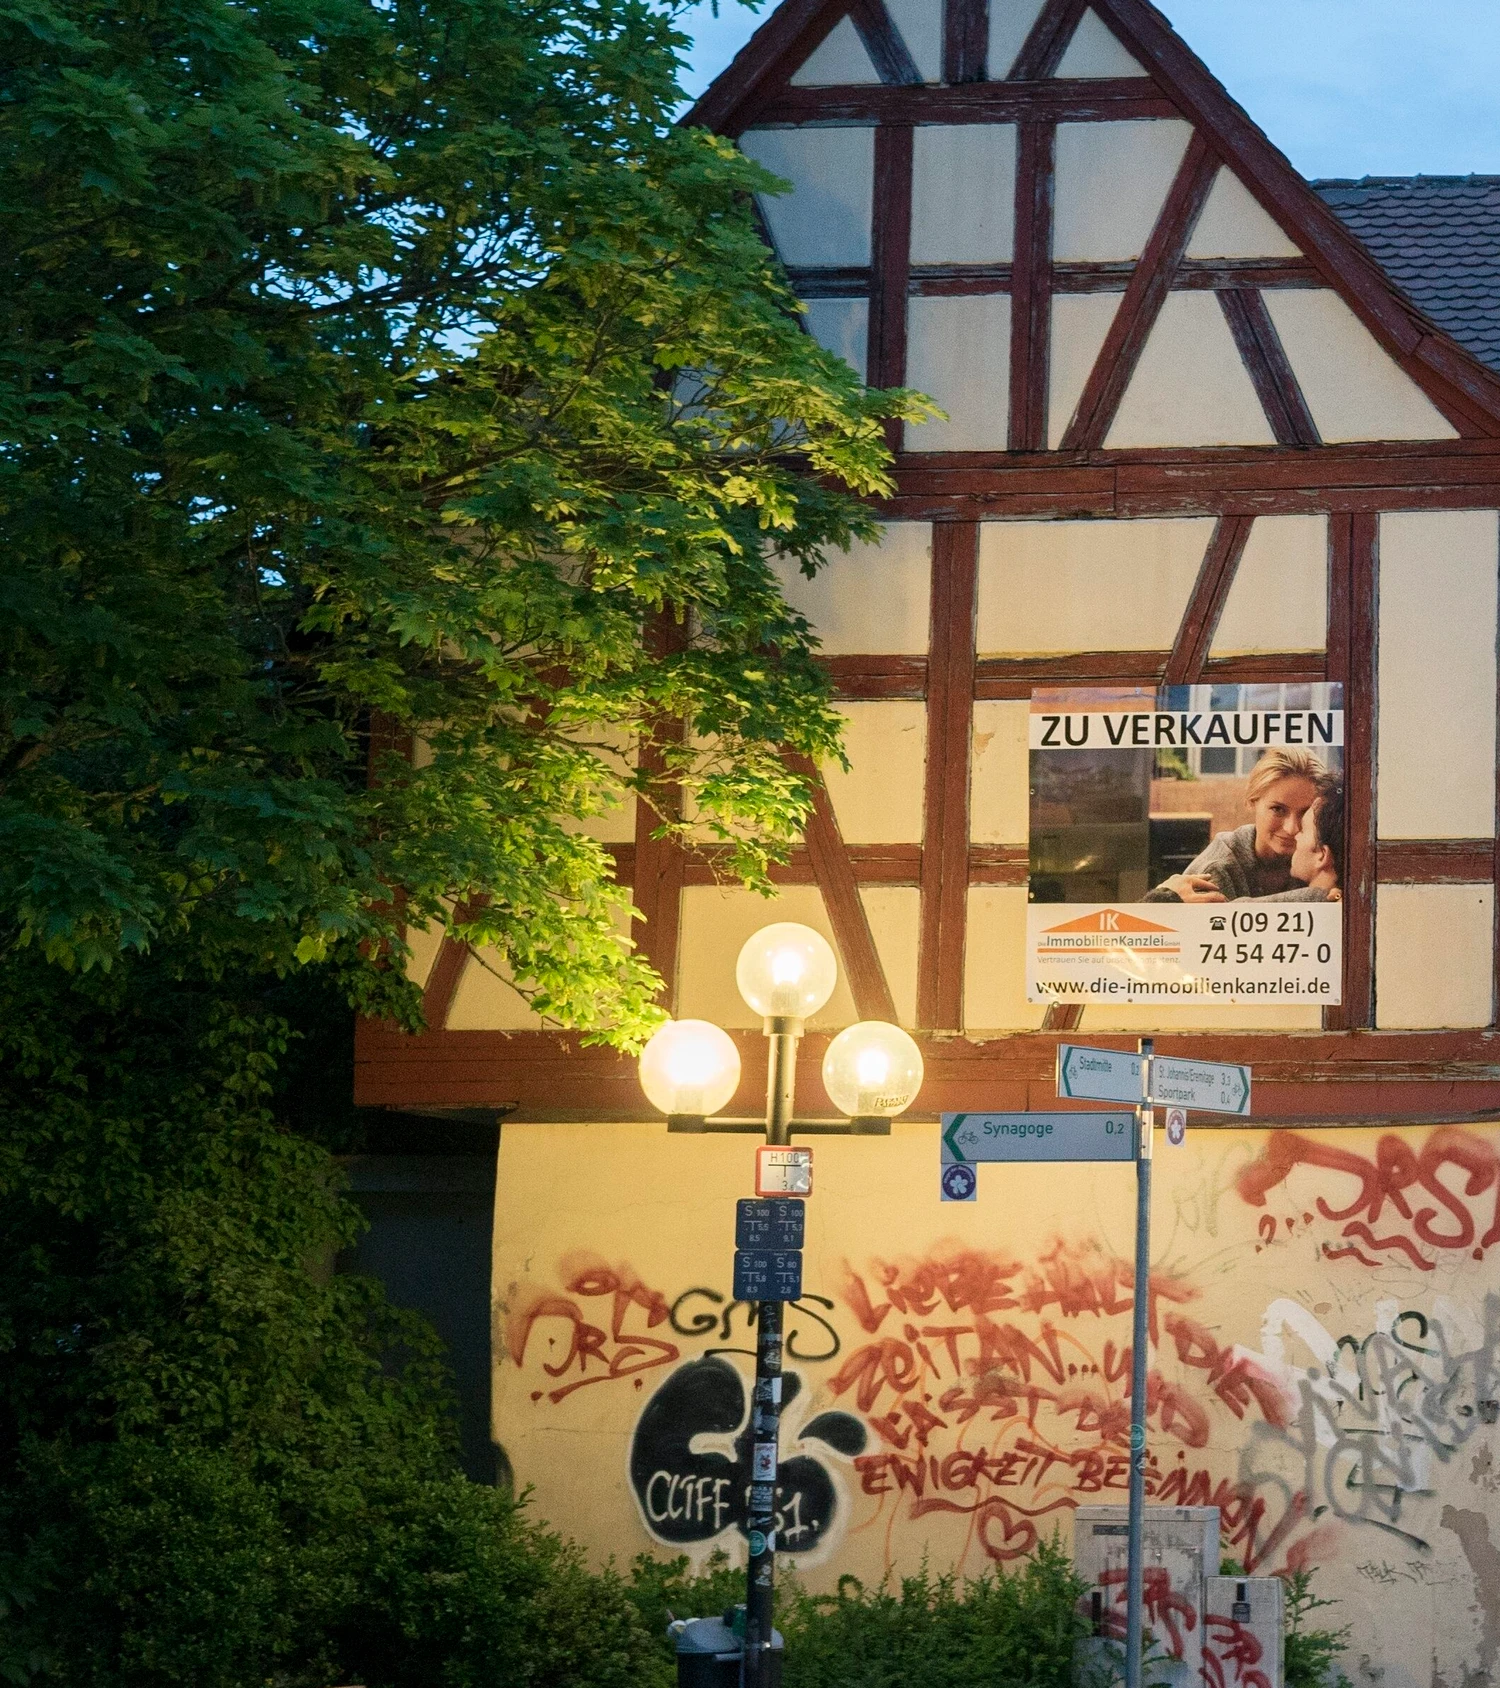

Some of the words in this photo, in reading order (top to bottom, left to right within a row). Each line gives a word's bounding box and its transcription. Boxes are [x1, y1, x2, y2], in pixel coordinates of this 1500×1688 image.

[1041, 715, 1089, 746] ZU
[1103, 713, 1333, 745] VERKAUFEN
[1099, 913, 1120, 931] IK
[1231, 911, 1268, 937] (09
[1277, 911, 1314, 937] 21)
[1037, 956, 1076, 964] Vertrauen
[1078, 955, 1090, 964] Sie
[1091, 955, 1104, 964] auf
[1200, 944, 1228, 963] 74
[1236, 944, 1264, 963] 54
[1317, 943, 1331, 963] 0
[1036, 977, 1330, 994] www.die-immobilienkanzlei.de
[1158, 1084, 1196, 1102] Sportpark
[983, 1121, 1054, 1138] Synagoge
